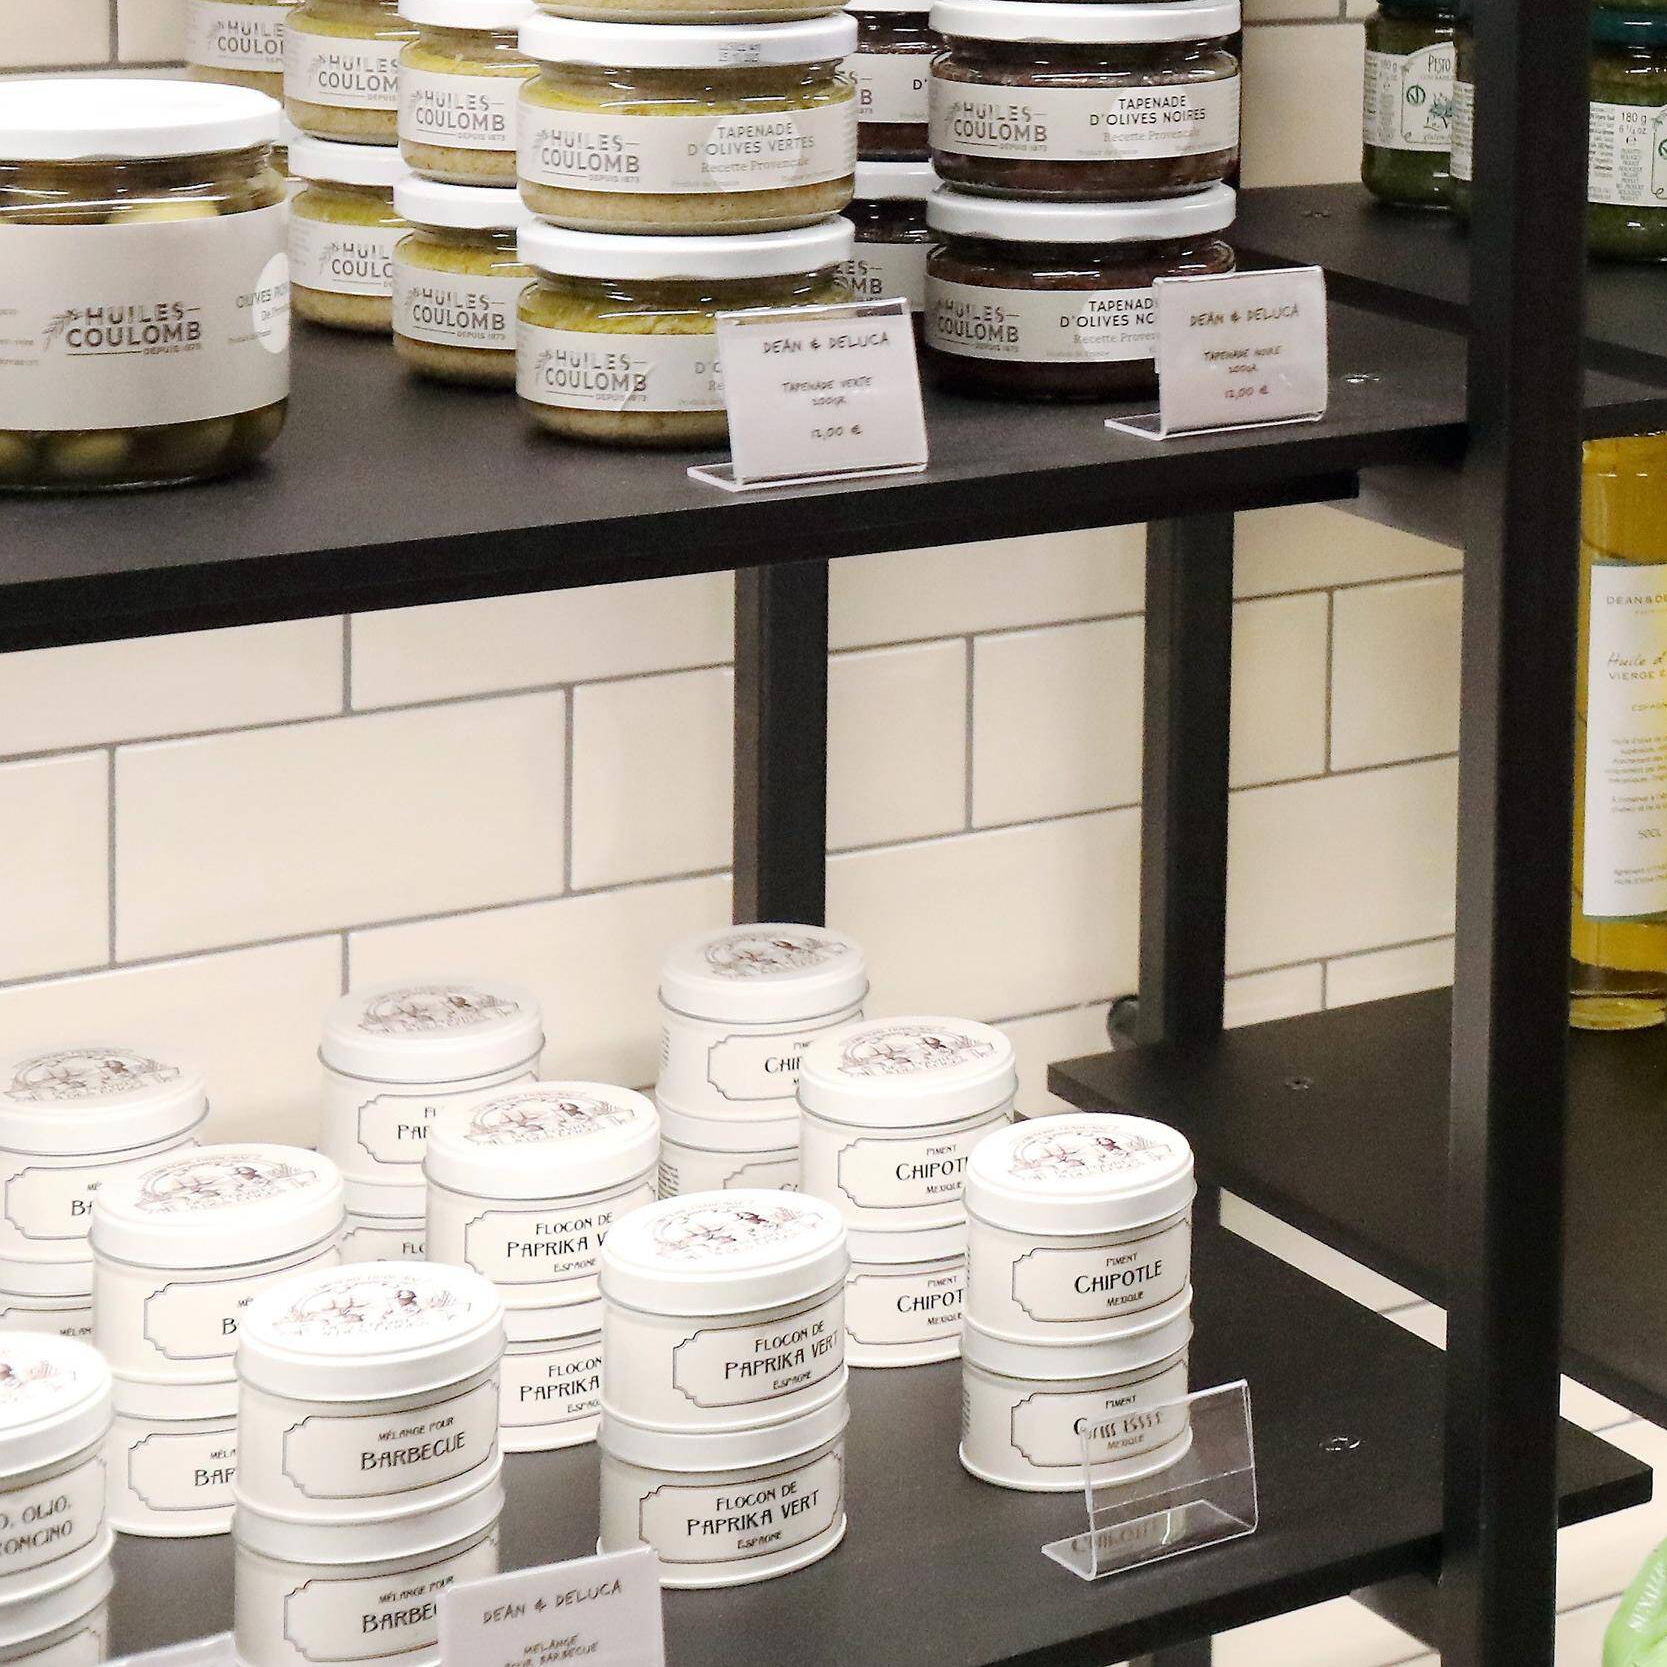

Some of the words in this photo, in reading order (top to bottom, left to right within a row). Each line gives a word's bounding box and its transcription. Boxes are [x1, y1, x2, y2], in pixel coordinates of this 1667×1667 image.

[424, 91, 489, 110] HUILES
[1118, 94, 1187, 109] TAPENADE
[416, 108, 505, 131] COULOMB
[964, 103, 1031, 122] HUILES
[1090, 111, 1157, 127] D'OLIVES
[1163, 108, 1205, 123] NOIRES
[1621, 112, 1638, 123] 180
[551, 129, 623, 151] HUILES
[717, 123, 793, 138] TAPENADE
[954, 120, 1047, 141] COULOMB
[688, 140, 761, 155] D'OLIVES
[769, 137, 815, 151] VERTES
[541, 148, 640, 173] COULOMB
[423, 287, 489, 311] HUILES
[85, 301, 184, 326] HUILES
[413, 304, 505, 331] COULOMB
[1060, 313, 1129, 328] D'OLIVES
[1189, 313, 1225, 327] DEAN
[1248, 305, 1299, 325] DELUCA
[67, 322, 201, 348] COULOMB
[938, 318, 1019, 343] COULOMB
[763, 339, 801, 354] DEAN
[829, 332, 889, 349] DELUCA
[546, 368, 647, 392] COULOMB
[1608, 670, 1655, 682] VIERGE
[536, 1218, 592, 1235] FLOCON
[598, 1212, 612, 1224] DE
[508, 1237, 588, 1258] PAPRIKA
[1074, 1260, 1163, 1294] CHIPOTLE
[755, 1330, 808, 1353] FLOCON
[812, 1320, 825, 1333] DE
[725, 1348, 805, 1379] PAPRIKA
[811, 1330, 838, 1358] VERT
[520, 1376, 600, 1402] PAPRIKA
[360, 1431, 465, 1471] BARBECUE
[716, 1488, 776, 1512] FLOCON
[781, 1481, 797, 1496] DE
[687, 1508, 773, 1537] PAPRIKA
[780, 1489, 819, 1519] VERT
[483, 1604, 526, 1624] DEAN
[556, 1580, 622, 1607] DELUCA
